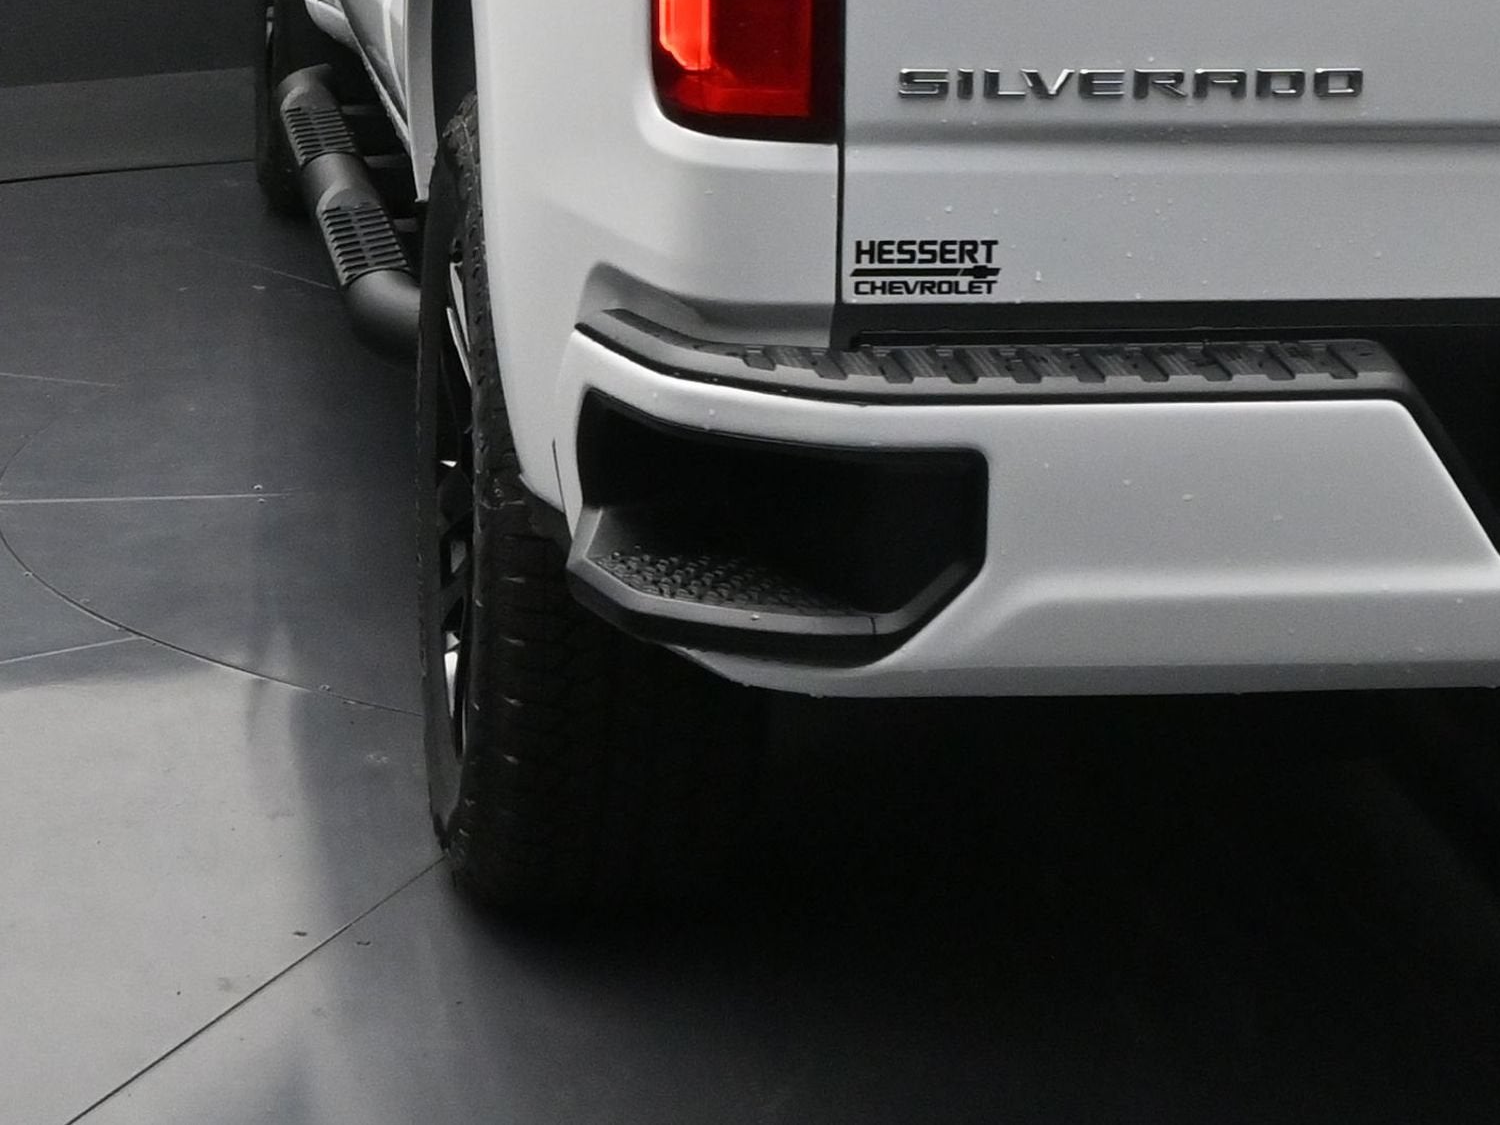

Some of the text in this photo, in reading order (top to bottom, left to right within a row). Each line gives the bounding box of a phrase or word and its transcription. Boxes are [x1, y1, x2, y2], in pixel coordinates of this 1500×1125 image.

[899, 68, 1363, 99] SILVERADO
[855, 240, 998, 264] HESSERT
[853, 280, 996, 295] CHEVROLET
